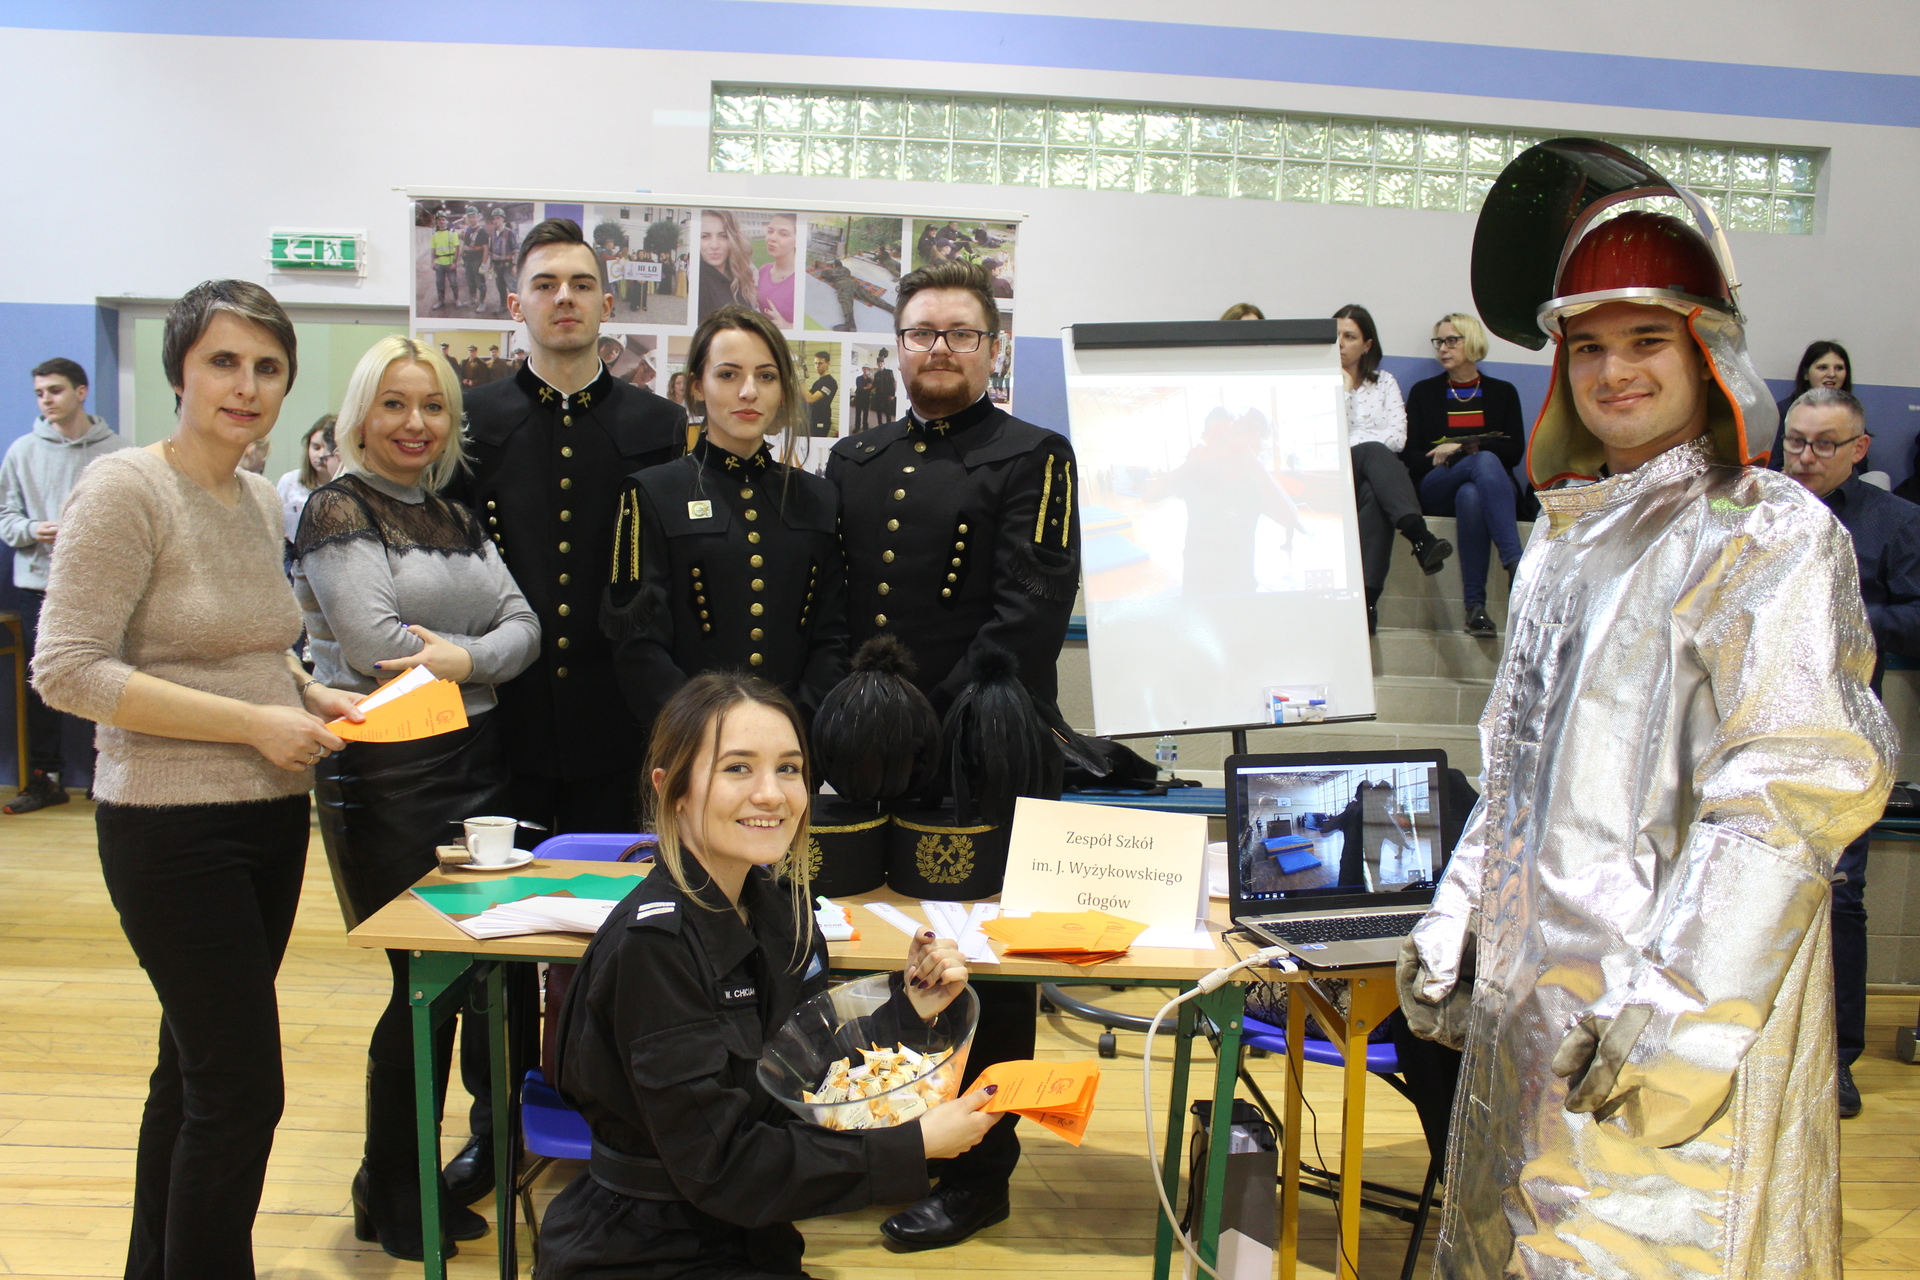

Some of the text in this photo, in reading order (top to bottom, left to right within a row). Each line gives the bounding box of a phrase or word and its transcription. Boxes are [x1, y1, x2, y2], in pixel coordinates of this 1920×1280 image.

[1066, 831, 1154, 850] Zespół Szkół
[1031, 858, 1183, 886] im. J. Wyżykowskiego
[1077, 892, 1131, 911] Głogów
